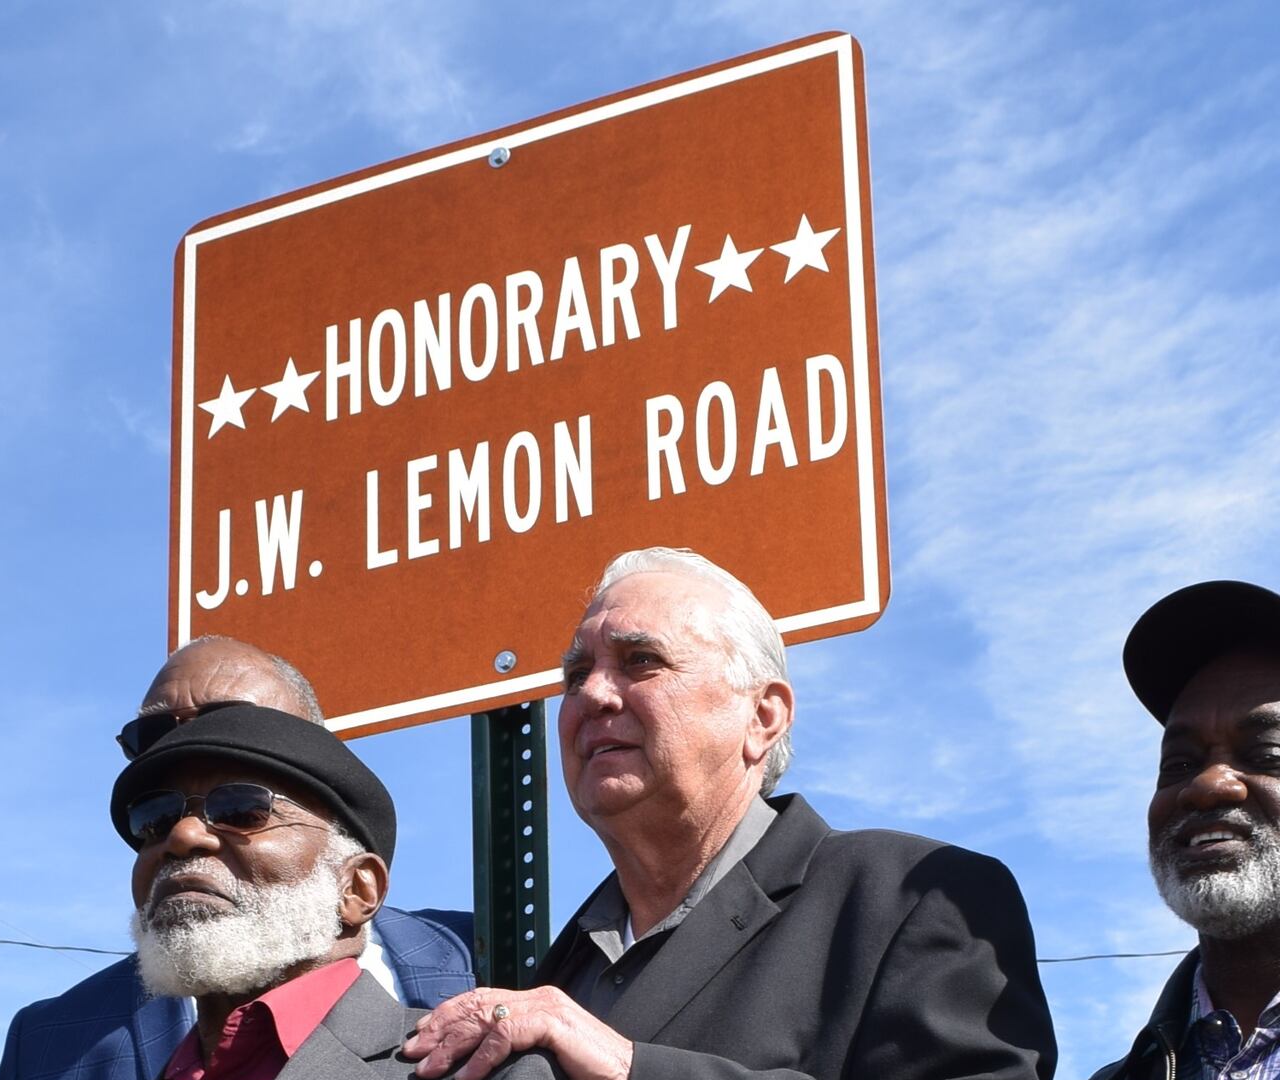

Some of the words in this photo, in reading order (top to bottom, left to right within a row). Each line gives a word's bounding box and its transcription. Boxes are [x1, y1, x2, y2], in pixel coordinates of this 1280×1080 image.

[325, 224, 692, 422] HONORARY
[195, 489, 323, 610] J.W.
[366, 414, 593, 570] LEMON
[645, 353, 848, 501] ROAD
